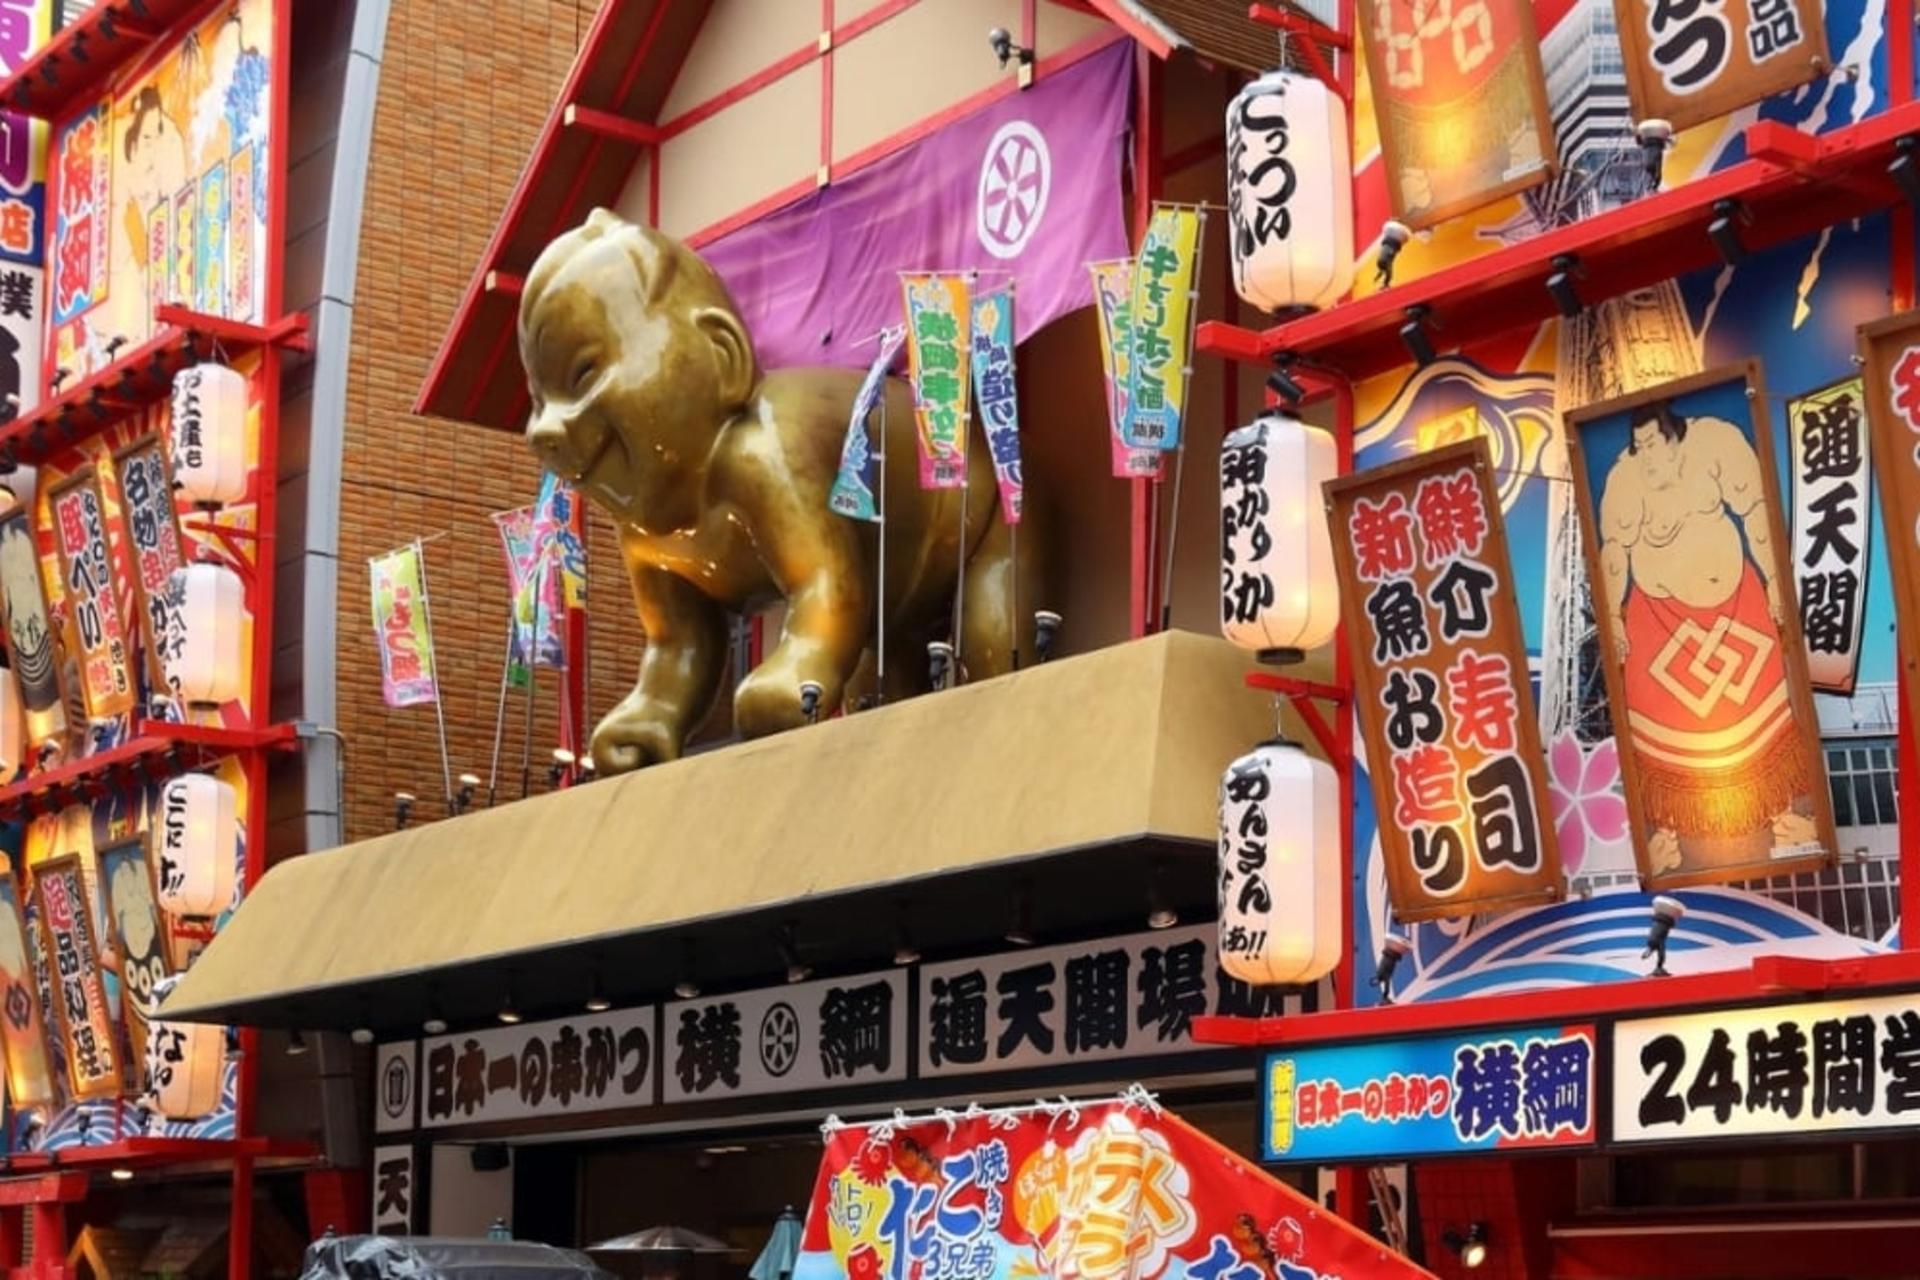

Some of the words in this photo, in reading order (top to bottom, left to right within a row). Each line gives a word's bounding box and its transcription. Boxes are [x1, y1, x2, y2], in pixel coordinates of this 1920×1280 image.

[1800, 394, 1863, 654] 通天閣
[428, 1026, 650, 1120] 日本一の串かつ
[1297, 1075, 1449, 1126] 日本一の串かつ
[1454, 1037, 1590, 1138] 横綱
[377, 1157, 409, 1235] 天
